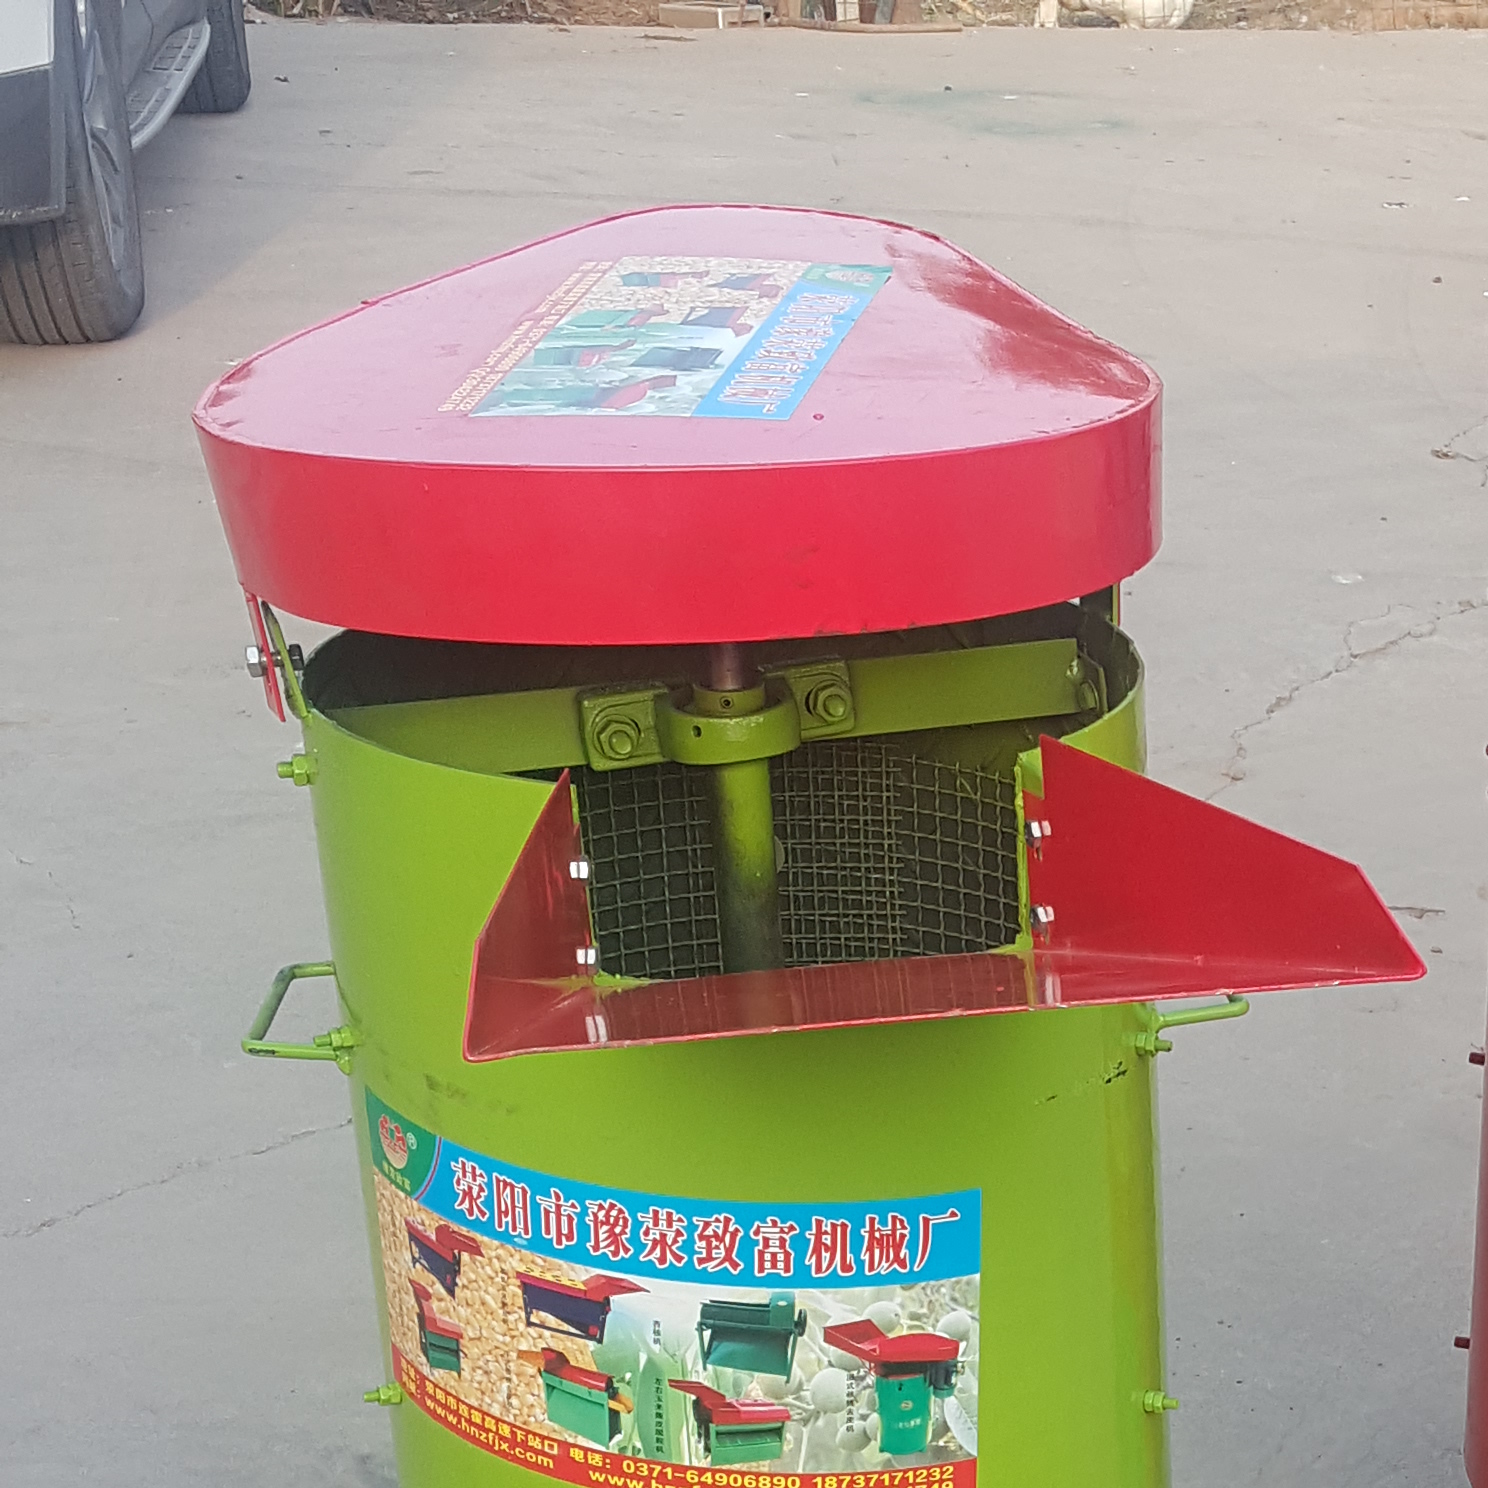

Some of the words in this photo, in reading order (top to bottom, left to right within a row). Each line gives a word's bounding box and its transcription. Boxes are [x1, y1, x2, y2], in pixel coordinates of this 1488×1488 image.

[451, 1158, 960, 1276] 荥阳市豫荥致富机械厂
[425, 1397, 555, 1469] www.hnzfjx.com
